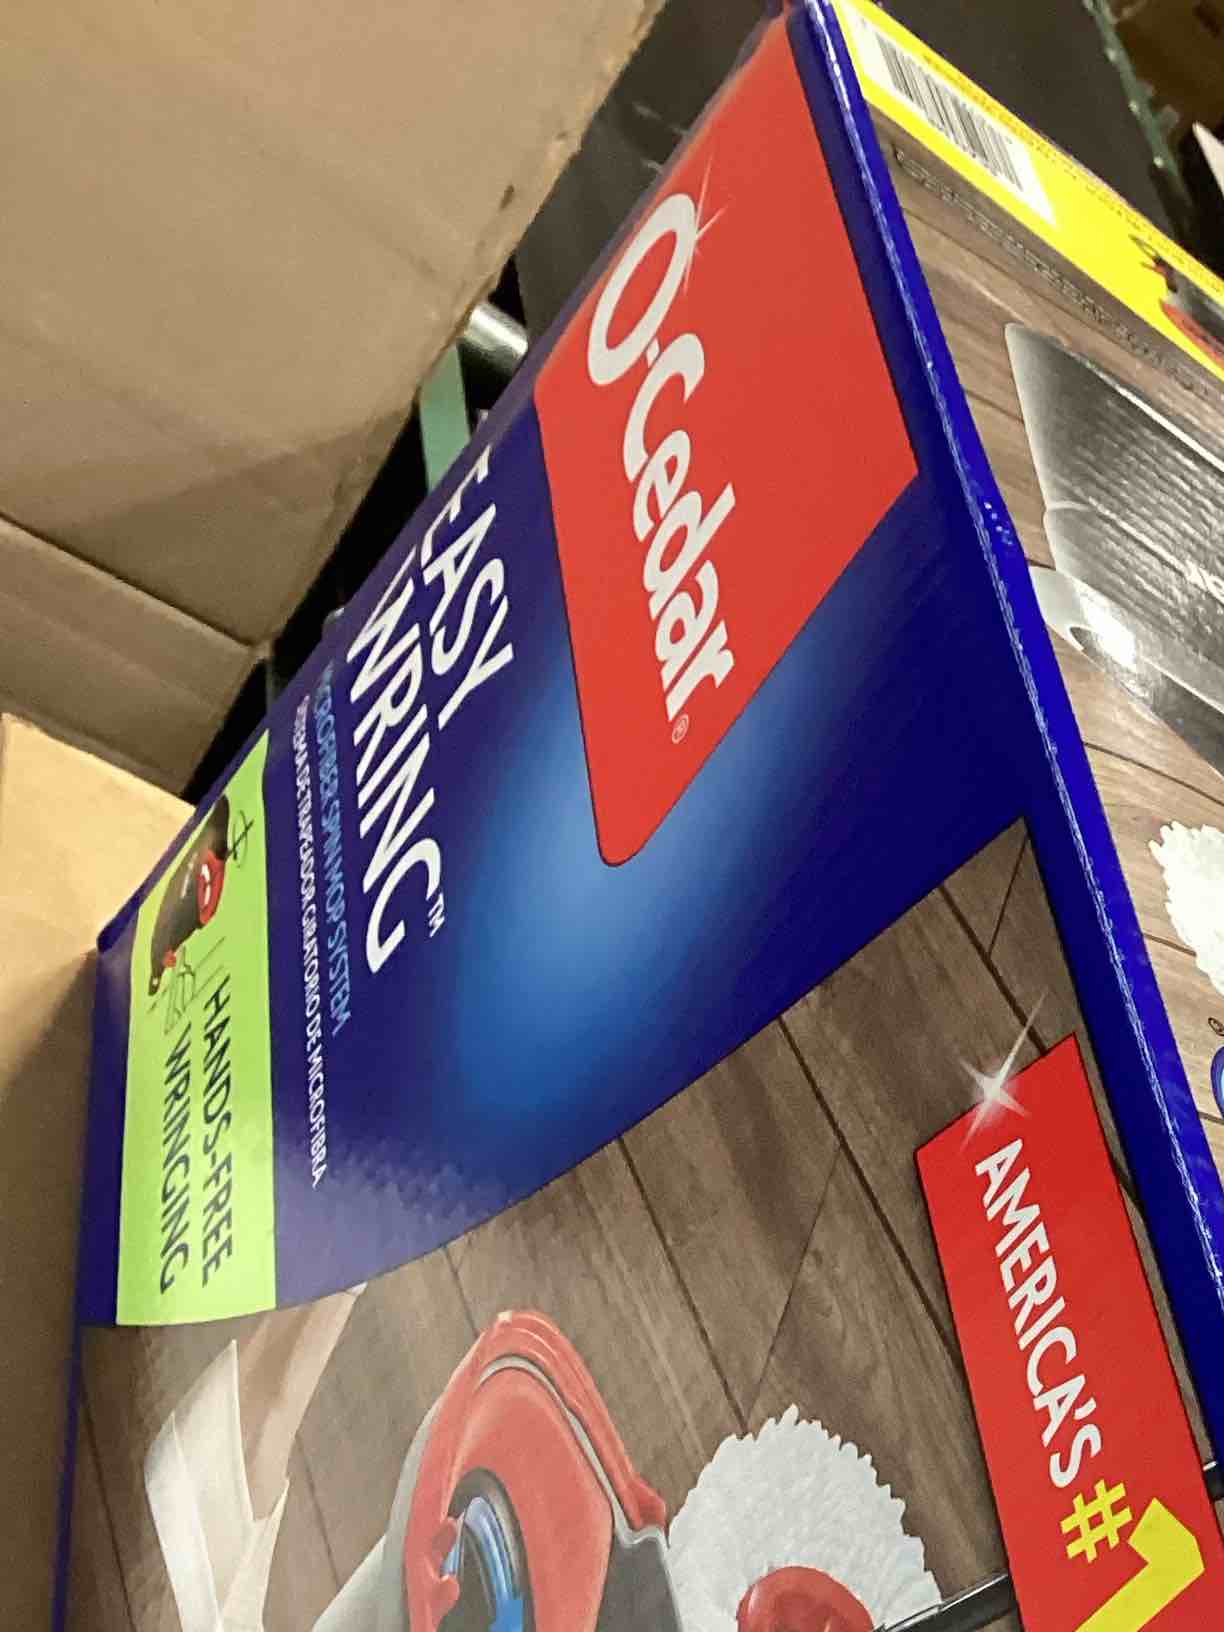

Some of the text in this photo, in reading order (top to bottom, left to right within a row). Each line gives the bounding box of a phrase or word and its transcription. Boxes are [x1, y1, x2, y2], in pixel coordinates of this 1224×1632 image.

[421, 446, 514, 730] EASY
[302, 903, 320, 1018] GIRATORIO
[306, 1012, 322, 1050] DE
[328, 920, 351, 1036] SYSTEM
[160, 1021, 192, 1295] WRINGING
[202, 975, 232, 1288] HANDS-FREE
[308, 1044, 328, 1188] MICROFIBRA
[975, 1139, 1102, 1488] AMERICA'S
